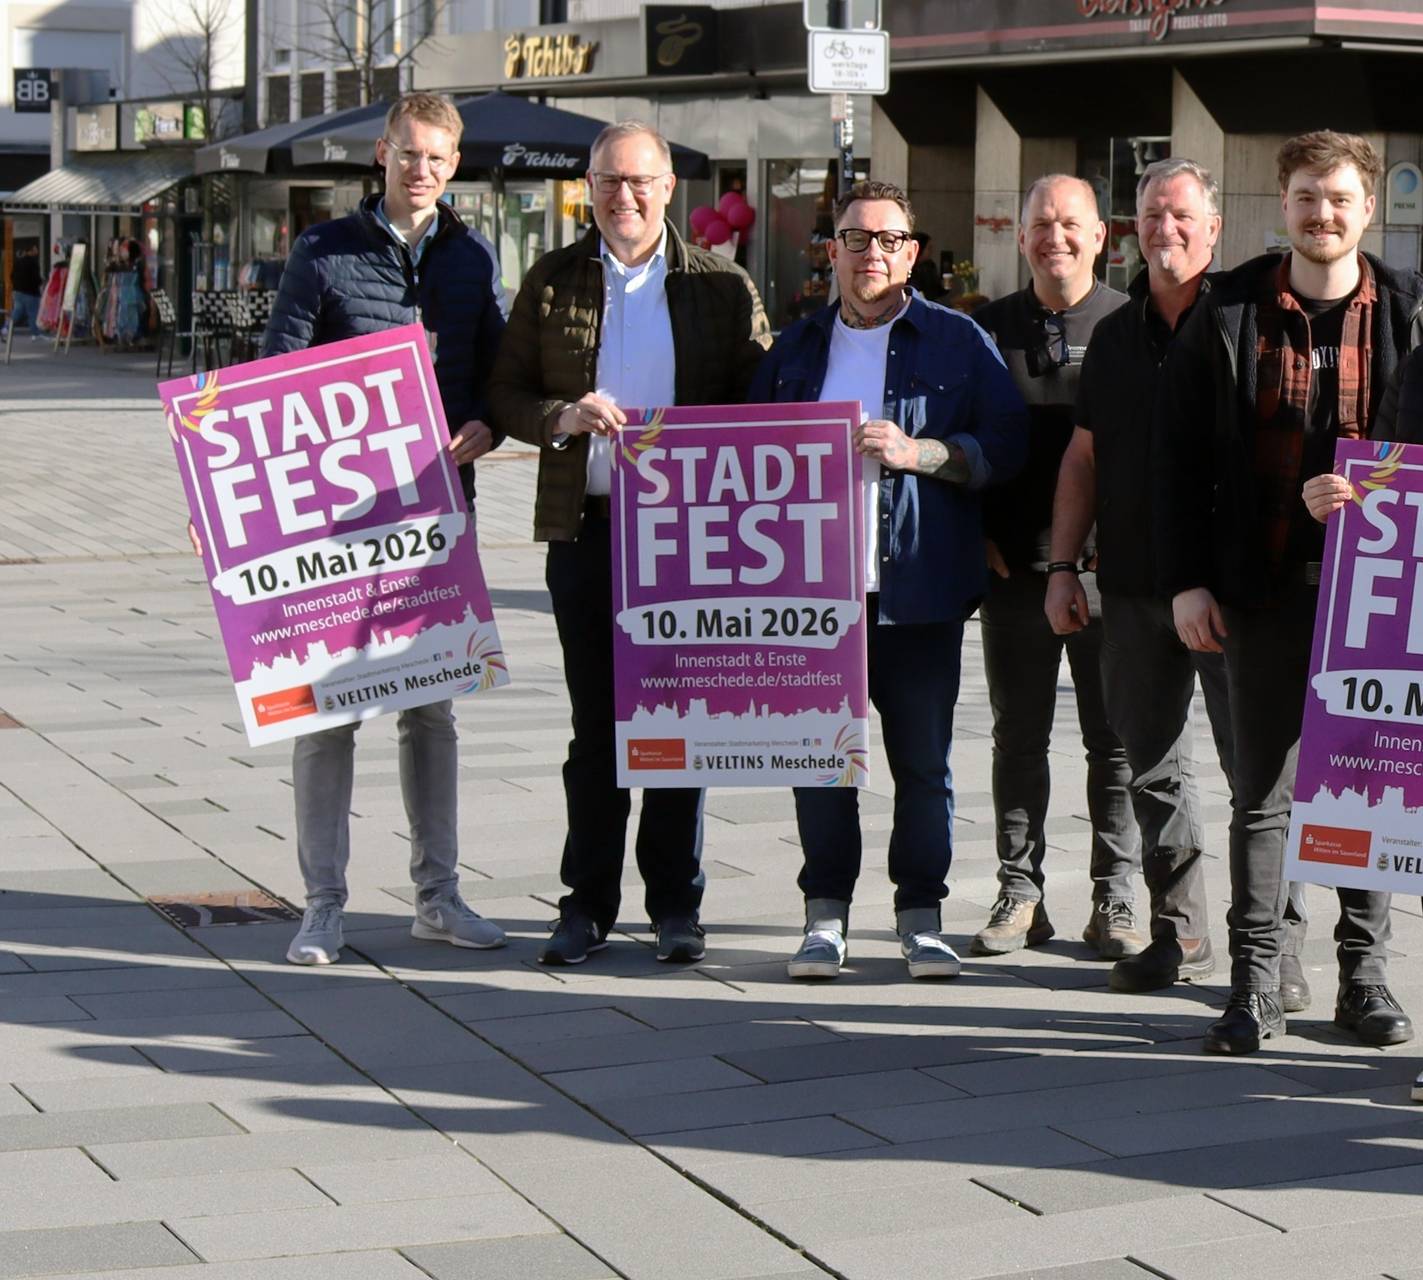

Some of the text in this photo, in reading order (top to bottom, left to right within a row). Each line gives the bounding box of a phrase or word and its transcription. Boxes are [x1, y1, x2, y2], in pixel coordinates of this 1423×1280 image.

[523, 33, 593, 77] Tchibo
[858, 46, 876, 55] frei
[524, 150, 580, 168] Tchibo
[199, 368, 404, 469] STADT
[210, 424, 422, 548] FEST
[636, 443, 832, 505] STADT
[239, 523, 447, 596] 10. Mai 2026
[637, 502, 838, 587] FEST
[251, 584, 461, 645] www.meschede.de/stadtfest
[282, 574, 421, 618] Innenstadt & Enste
[642, 607, 839, 639] 10. Mai 2026
[640, 671, 842, 688] www.meschede.de/stadtfest
[675, 652, 806, 668] Innenstadt & Enste
[337, 661, 482, 707] VELTINS Meschede
[1342, 677, 1394, 714] 10.
[706, 754, 845, 770] VELTINS Meschede
[1382, 836, 1421, 848] Veranstalter:
